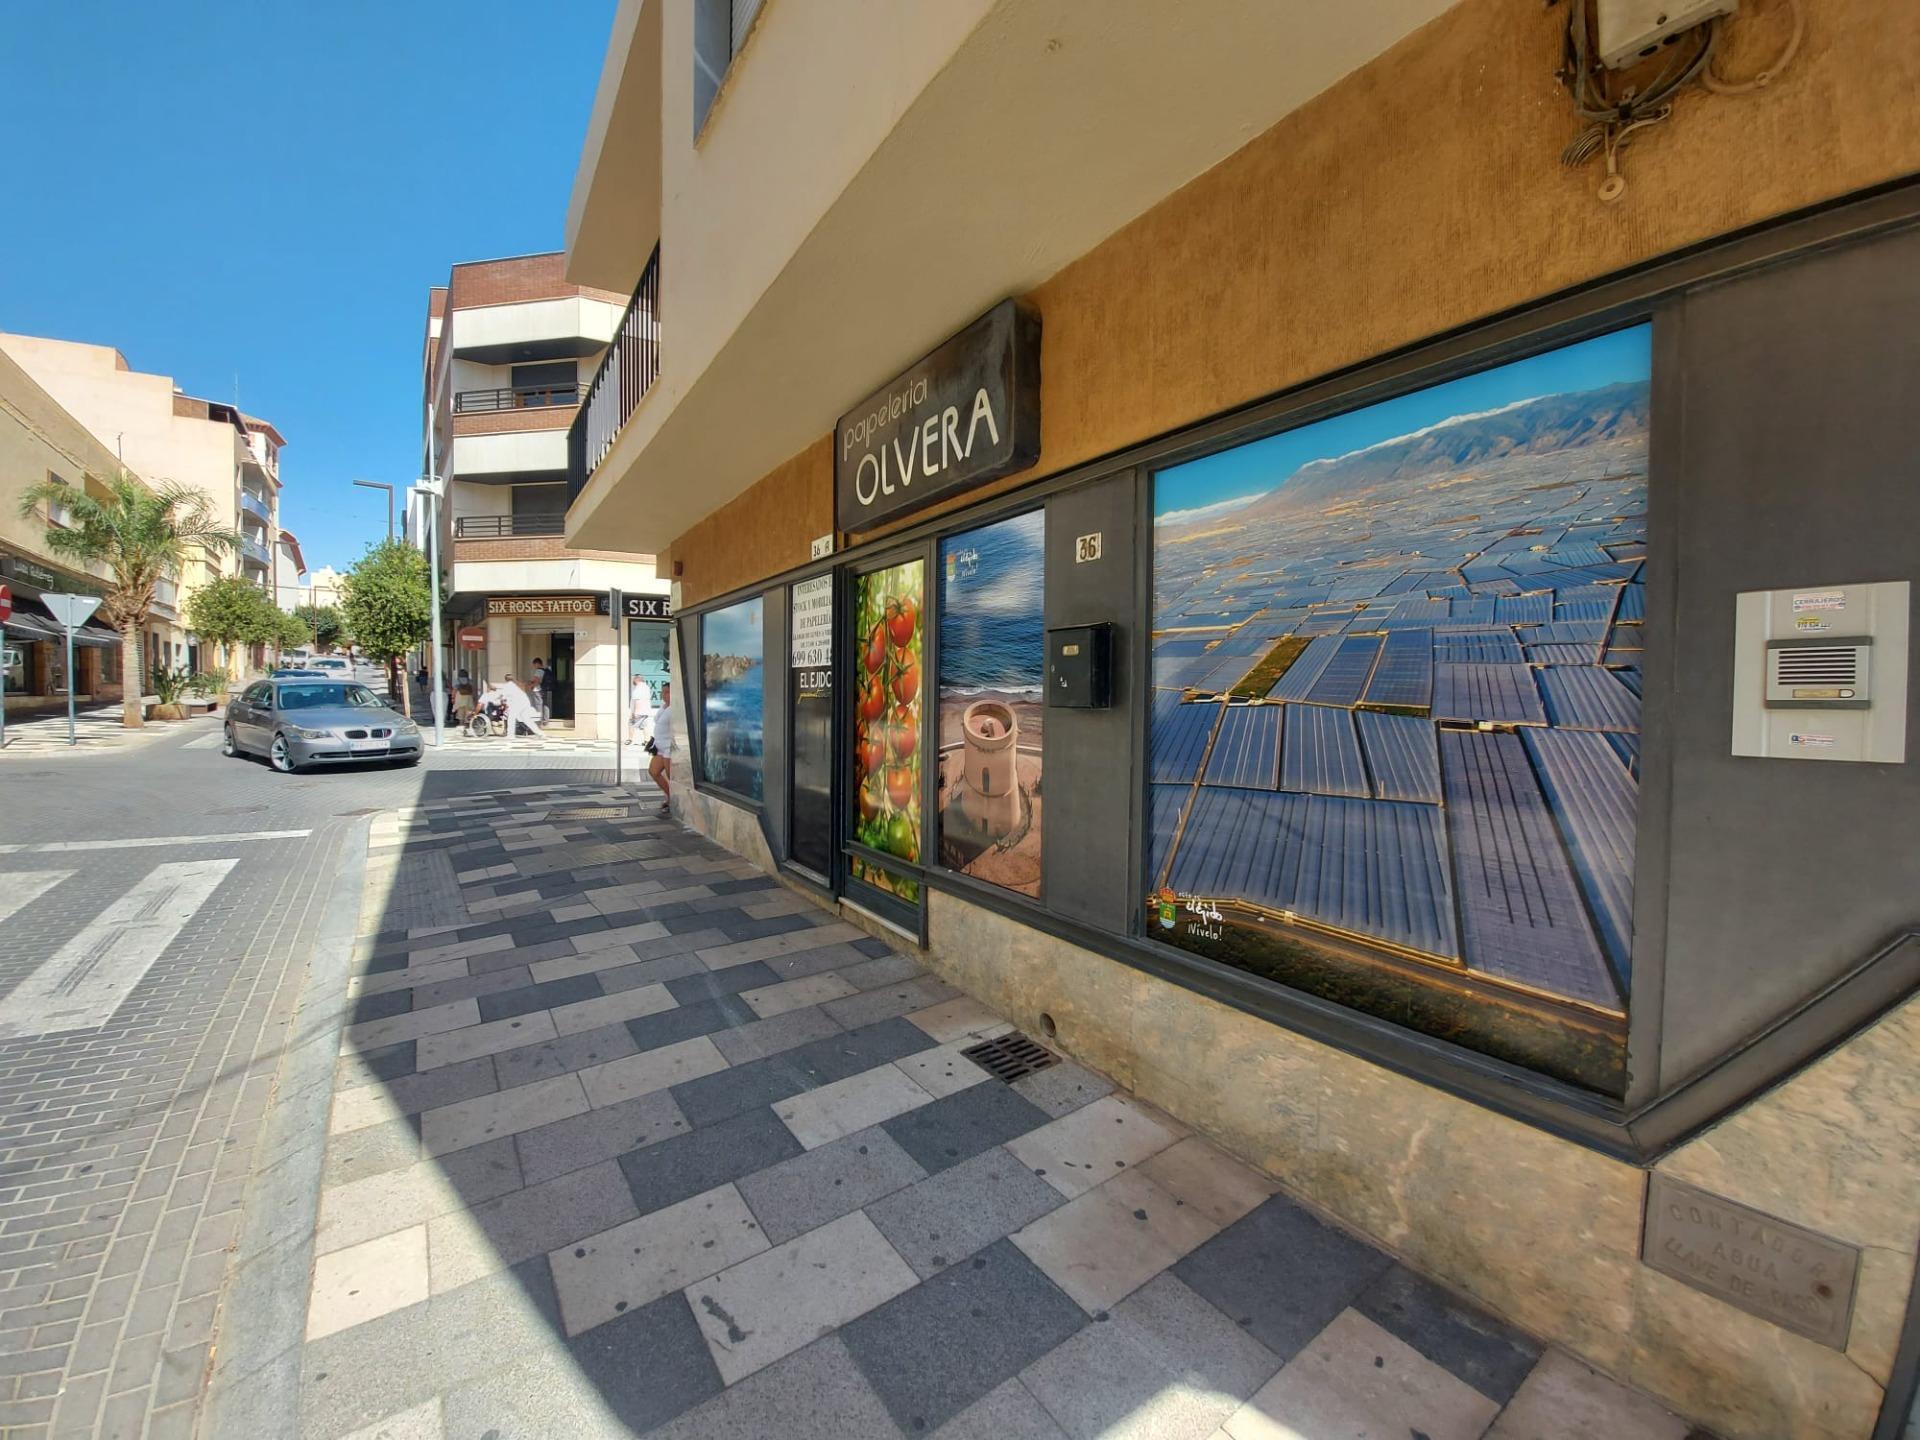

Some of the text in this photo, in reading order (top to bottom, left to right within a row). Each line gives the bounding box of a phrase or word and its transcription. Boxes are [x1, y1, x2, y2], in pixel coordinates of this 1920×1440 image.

[843, 377, 928, 462] papeleria
[855, 387, 1000, 507] OLVERA
[813, 544, 821, 557] 36
[1079, 535, 1097, 561] 36
[488, 600, 507, 614] SIX
[509, 600, 544, 614] ROSES
[547, 599, 593, 613] TATTOO
[629, 599, 656, 616] SIX
[792, 650, 806, 666] 699
[807, 648, 822, 665] 630
[800, 672, 809, 689] EL
[1668, 1203, 1827, 1279] CONTADOR
[1728, 1274, 1755, 1298] DE
